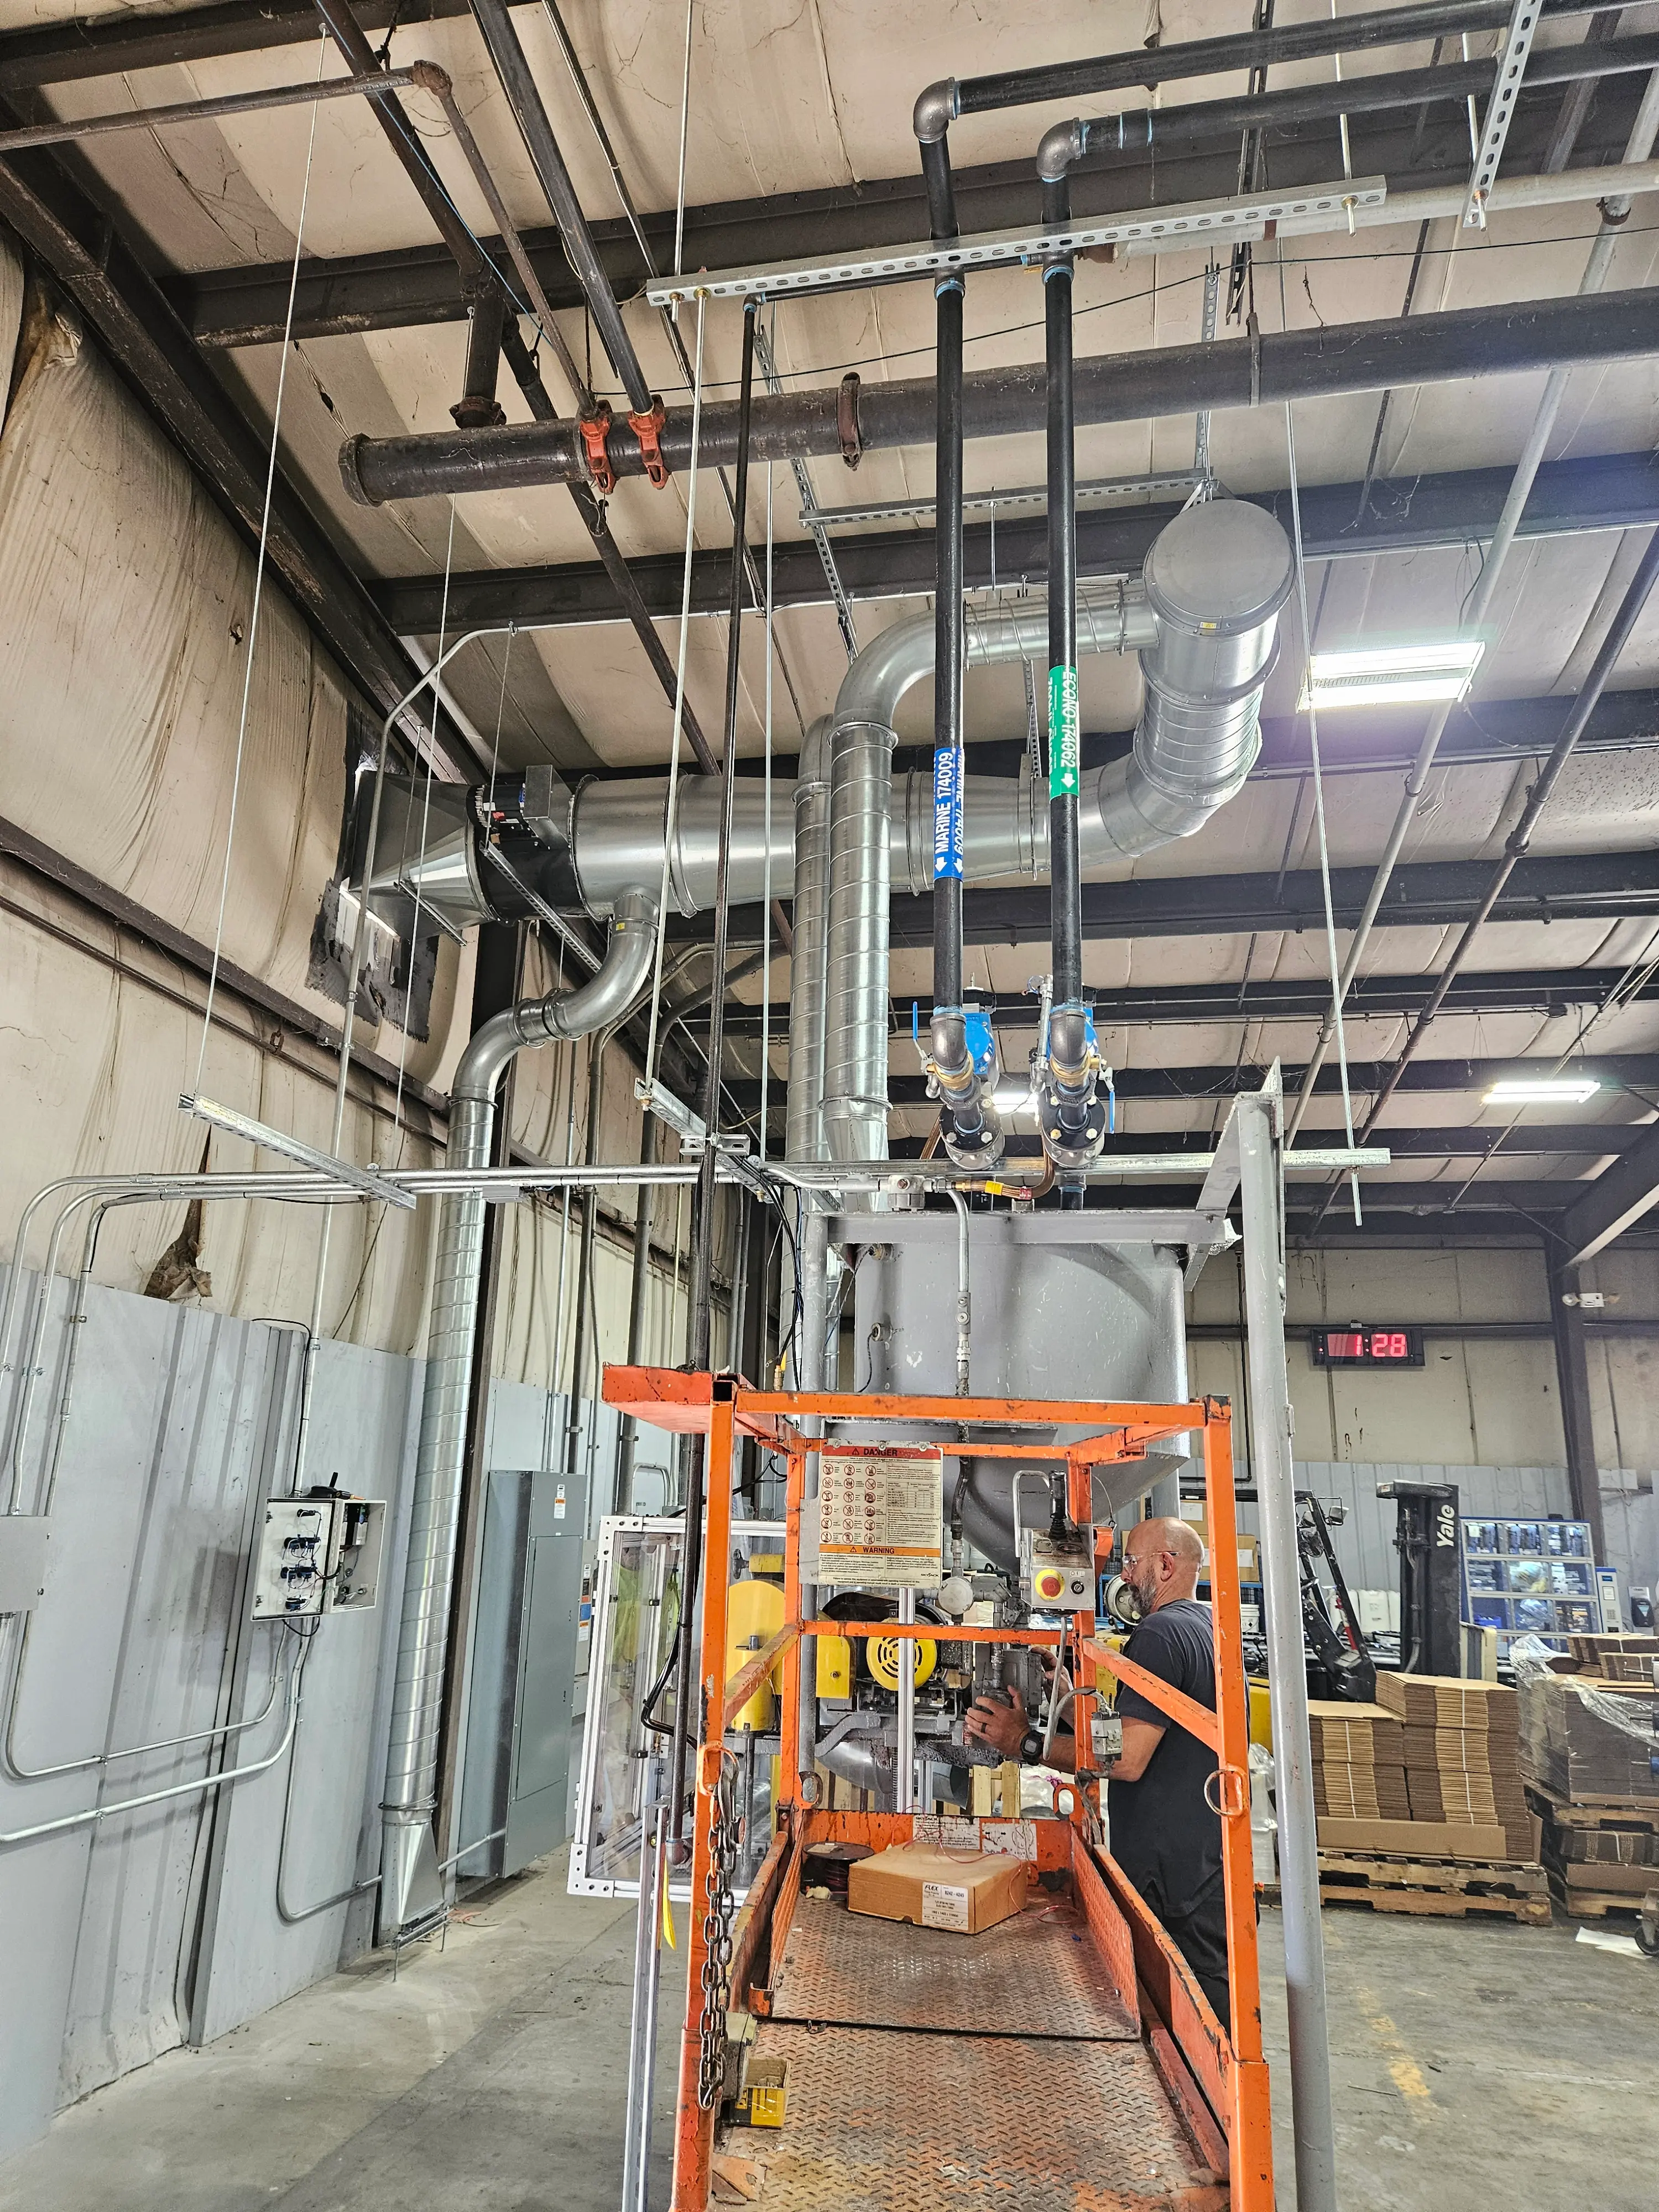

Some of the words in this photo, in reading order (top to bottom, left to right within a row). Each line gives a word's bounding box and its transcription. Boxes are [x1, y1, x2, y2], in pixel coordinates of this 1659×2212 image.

[1062, 671, 1077, 718] ECONO
[1061, 723, 1076, 768] 174062
[937, 752, 953, 799] 174009
[935, 801, 951, 854] MARINE
[1356, 1334, 1406, 1357] 1:28
[863, 1448, 898, 1457] DANGER
[1436, 1505, 1455, 1547] Yale
